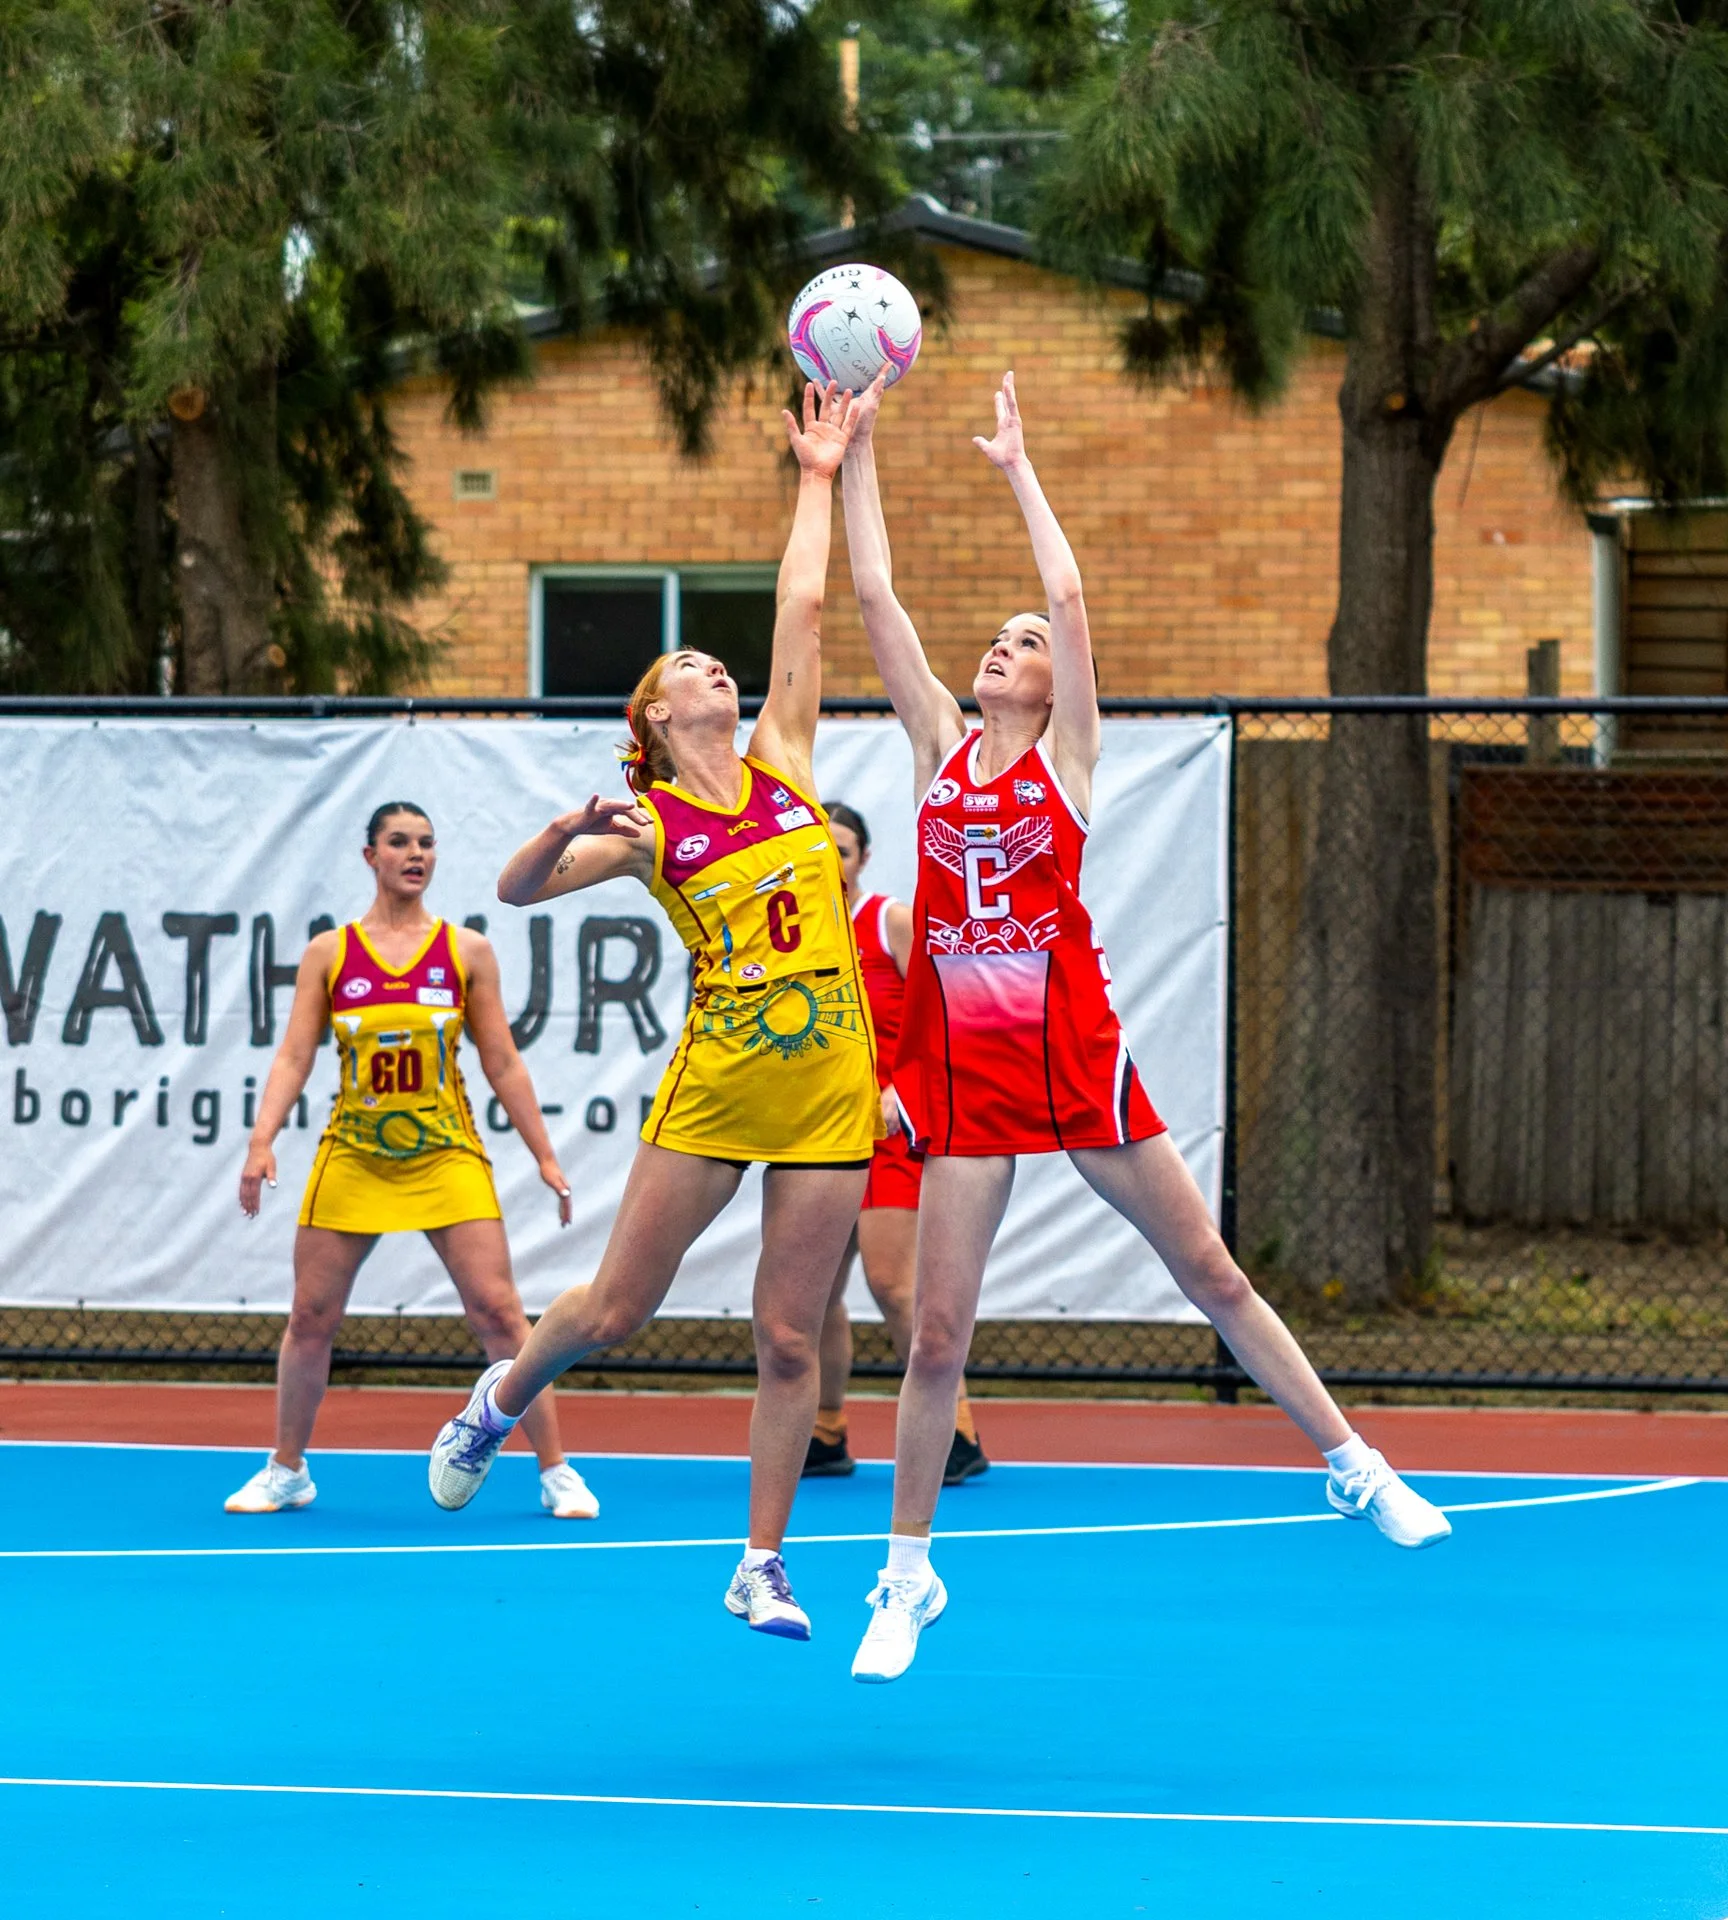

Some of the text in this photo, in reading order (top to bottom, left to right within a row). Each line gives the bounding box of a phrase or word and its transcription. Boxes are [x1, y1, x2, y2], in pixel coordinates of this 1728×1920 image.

[966, 795, 997, 806] SWD
[963, 845, 1012, 920] C
[767, 890, 801, 953] C
[371, 1048, 423, 1094] GD
